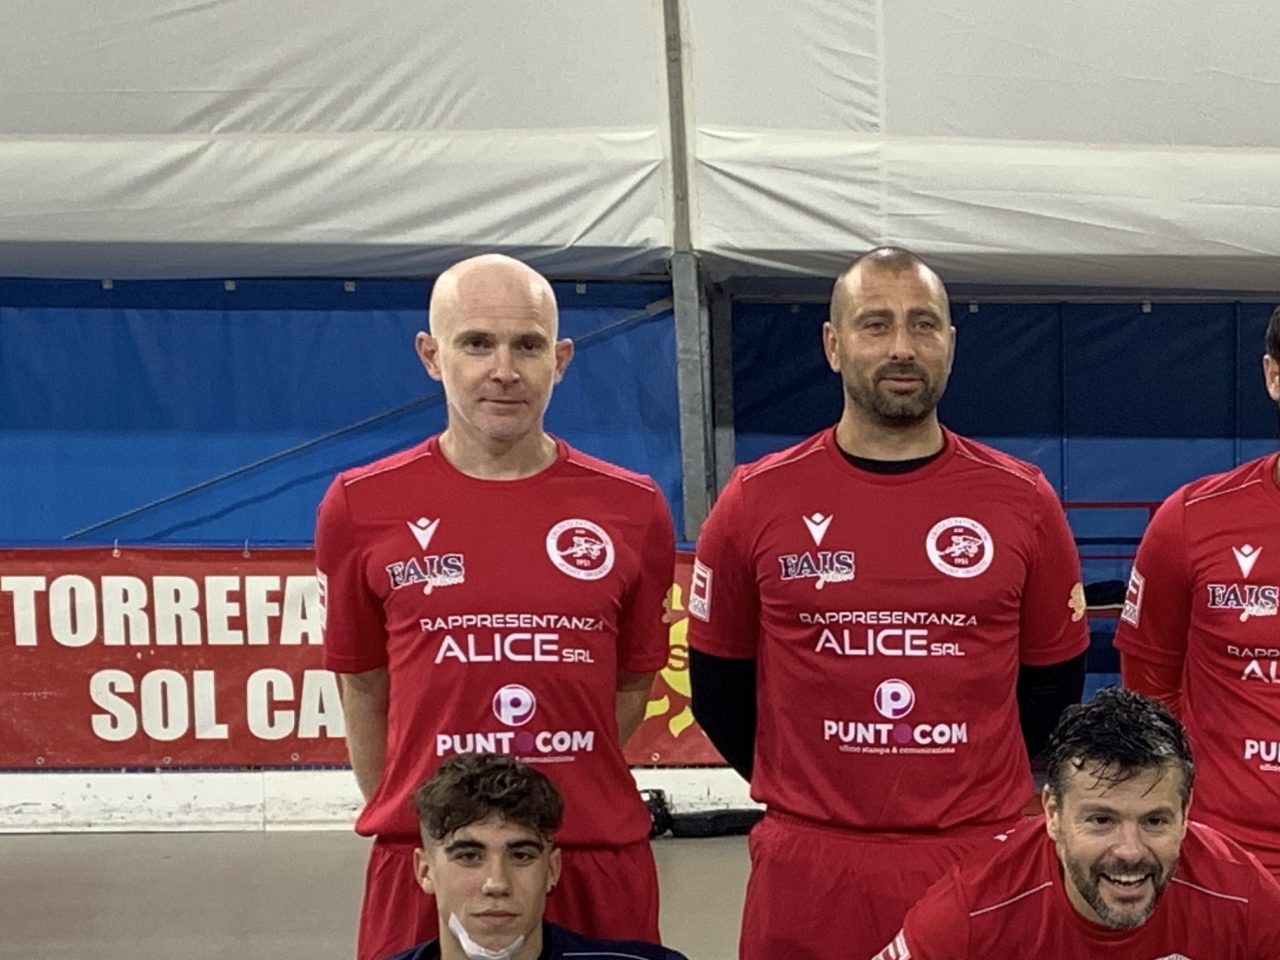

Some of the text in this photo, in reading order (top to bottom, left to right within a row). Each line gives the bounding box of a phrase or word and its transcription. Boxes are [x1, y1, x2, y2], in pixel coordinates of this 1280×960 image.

[0, 574, 324, 647] TORREFA
[420, 614, 604, 631] RAPPRESENTANZA
[800, 611, 977, 626] RAPPRESENTANZA
[434, 633, 594, 664] ALICE SRL
[815, 629, 965, 656] ALICE SRL
[90, 668, 347, 741] SOL CA
